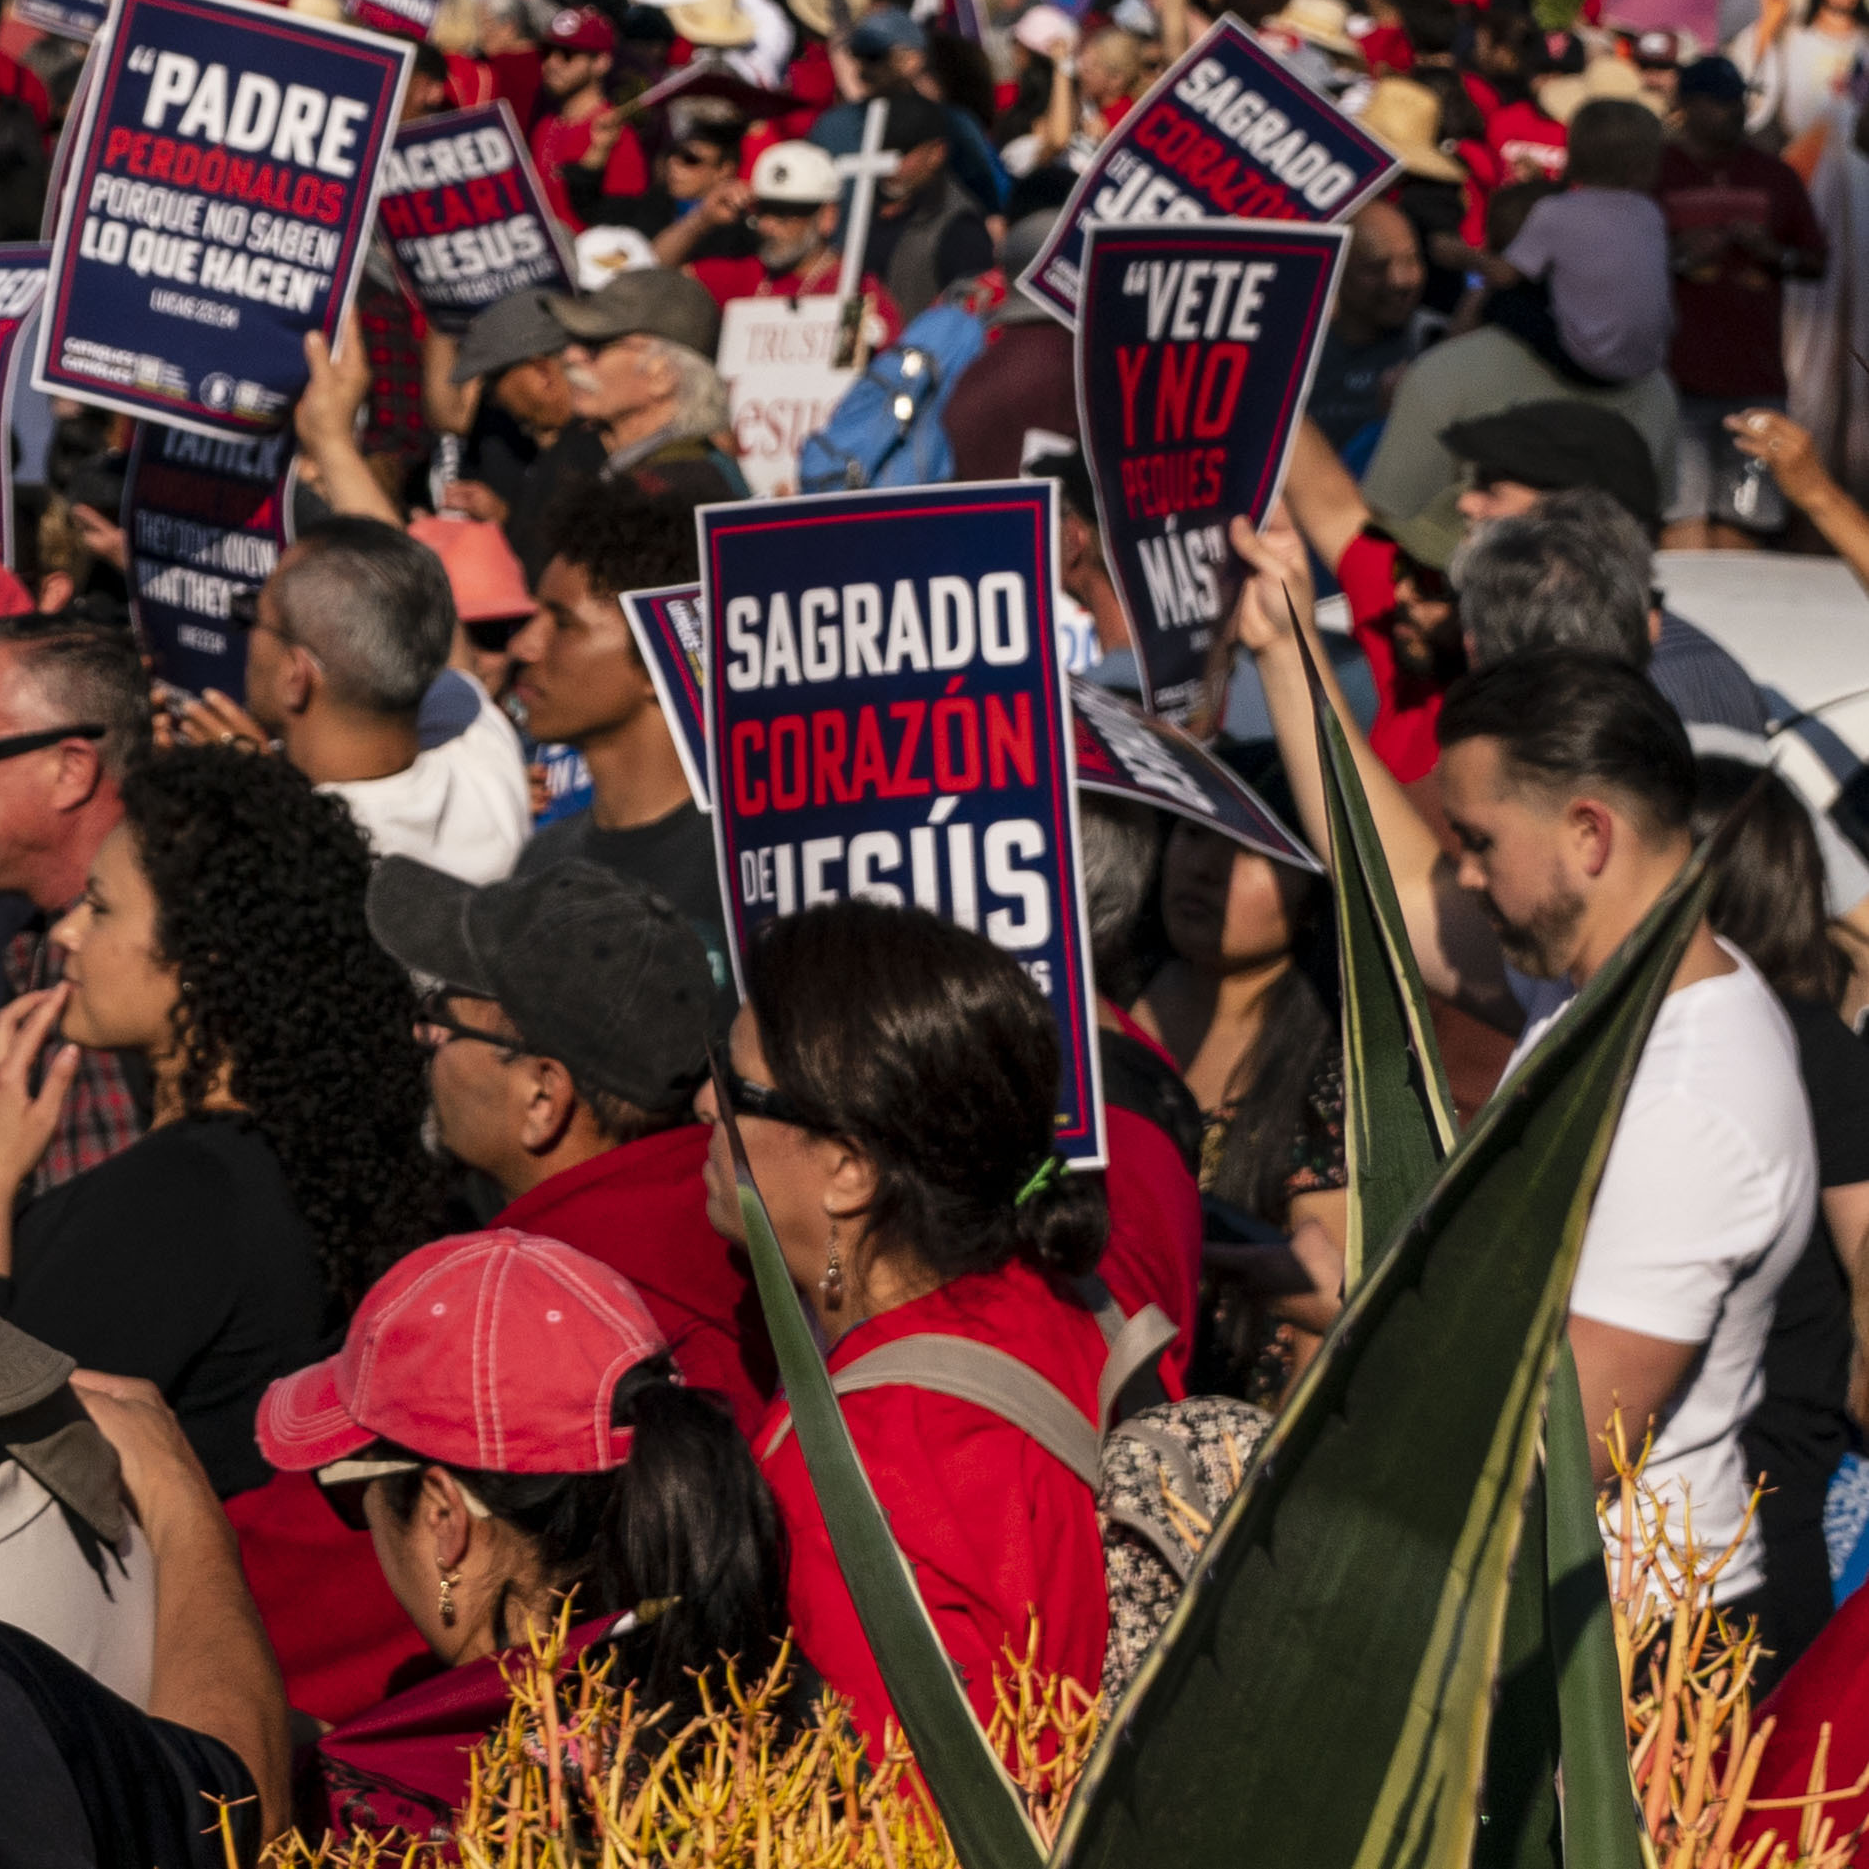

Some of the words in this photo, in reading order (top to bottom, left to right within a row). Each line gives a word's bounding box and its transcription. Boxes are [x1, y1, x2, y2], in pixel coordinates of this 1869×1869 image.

[128, 45, 368, 178] “PADRE
[1174, 57, 1357, 210] SAGRADO
[103, 127, 347, 224] PERDÓNALOS
[380, 168, 526, 241] HEART
[382, 127, 514, 195] ACRED
[79, 216, 128, 265] LO
[127, 232, 203, 284] QUE
[88, 173, 207, 235] PORQUE
[201, 199, 250, 247] NO
[245, 212, 340, 271] SABEN
[413, 213, 547, 283] JESUS
[1122, 260, 1278, 342] “VETE
[1115, 344, 1149, 448] Y
[1153, 340, 1250, 443] NO
[1119, 448, 1227, 521] PEQUES
[726, 571, 1029, 692] SAGRADO
[730, 675, 1038, 818] CORAZÓN
[739, 846, 775, 907] DE
